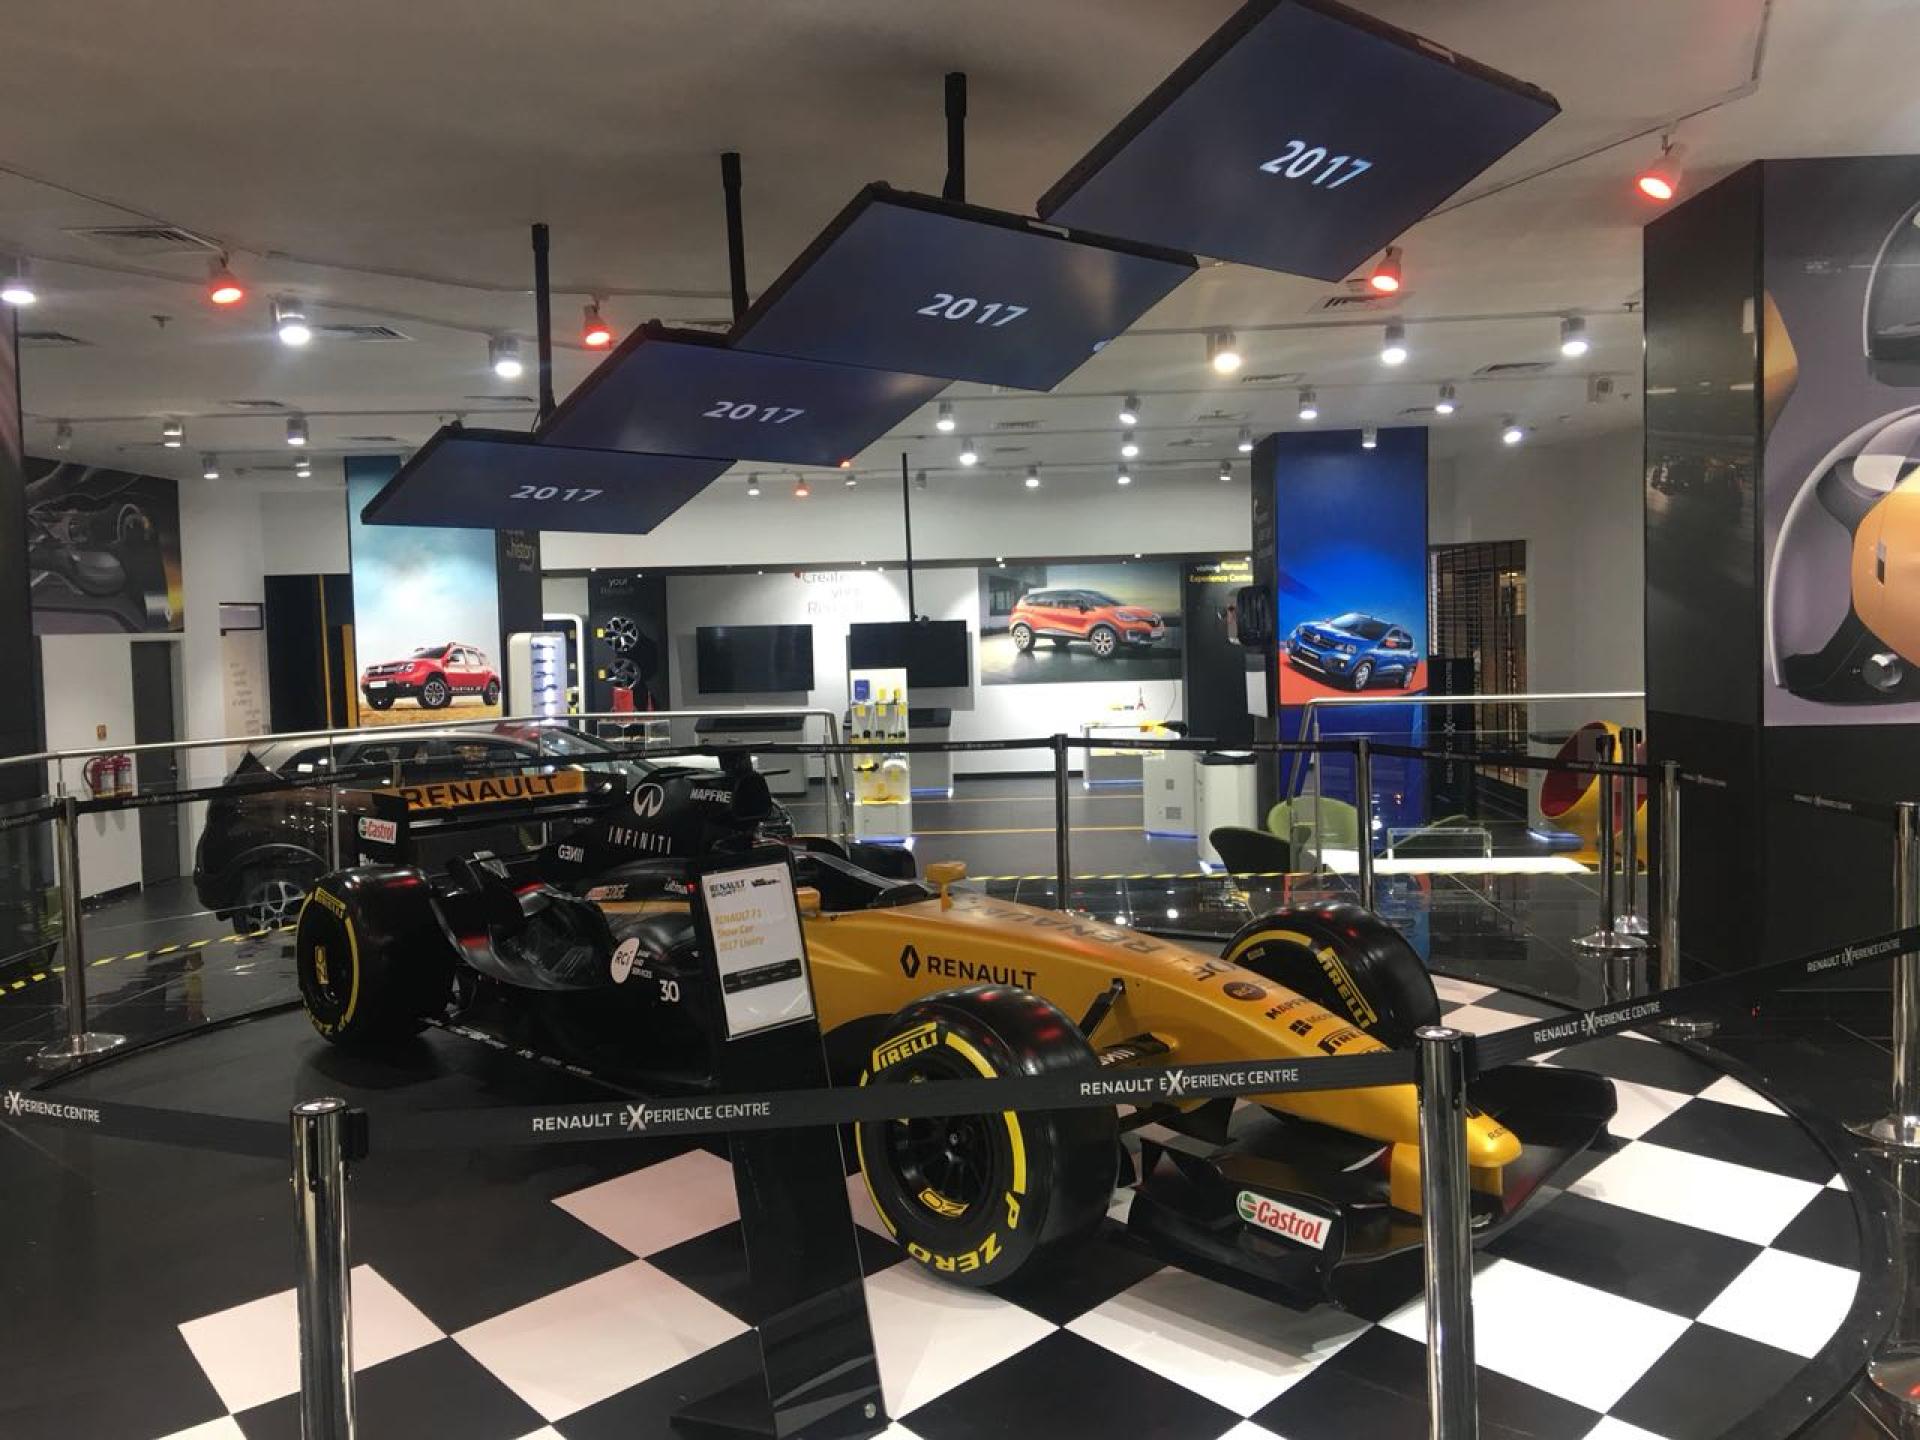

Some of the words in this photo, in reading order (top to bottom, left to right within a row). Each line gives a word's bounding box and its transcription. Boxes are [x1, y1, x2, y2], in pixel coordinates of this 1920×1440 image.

[1260, 138, 1373, 190] 2017
[917, 292, 1030, 328] 2017
[702, 401, 804, 424] 2017
[510, 485, 604, 502] 2017
[401, 774, 558, 808] RENAULT
[690, 788, 732, 803] MAPFRE
[366, 821, 394, 842] Castrol
[608, 826, 672, 855] INFINITI
[927, 956, 1037, 990] RENAULT
[1317, 947, 1377, 1029] PIRELLI
[659, 979, 680, 1003] 30
[1533, 1021, 1579, 1043] RENAULT
[1580, 1010, 1631, 1037] EXPERIENCE
[1631, 1001, 1661, 1019] CENTRE
[872, 1022, 938, 1073] PIRELLI
[1080, 1078, 1153, 1096] RENAULT
[1159, 1069, 1245, 1096] EXPERIENCE
[1247, 1068, 1299, 1084] CENTRE
[3, 1089, 63, 1116] EXPERIENCE
[63, 1104, 101, 1123] CENTRE
[532, 1112, 613, 1132] RENAULT
[619, 1103, 712, 1132] EXPERIENCE
[716, 1102, 771, 1119] CENTRE
[1256, 1201, 1323, 1244] Castrol
[907, 1232, 1002, 1273] ZERO
